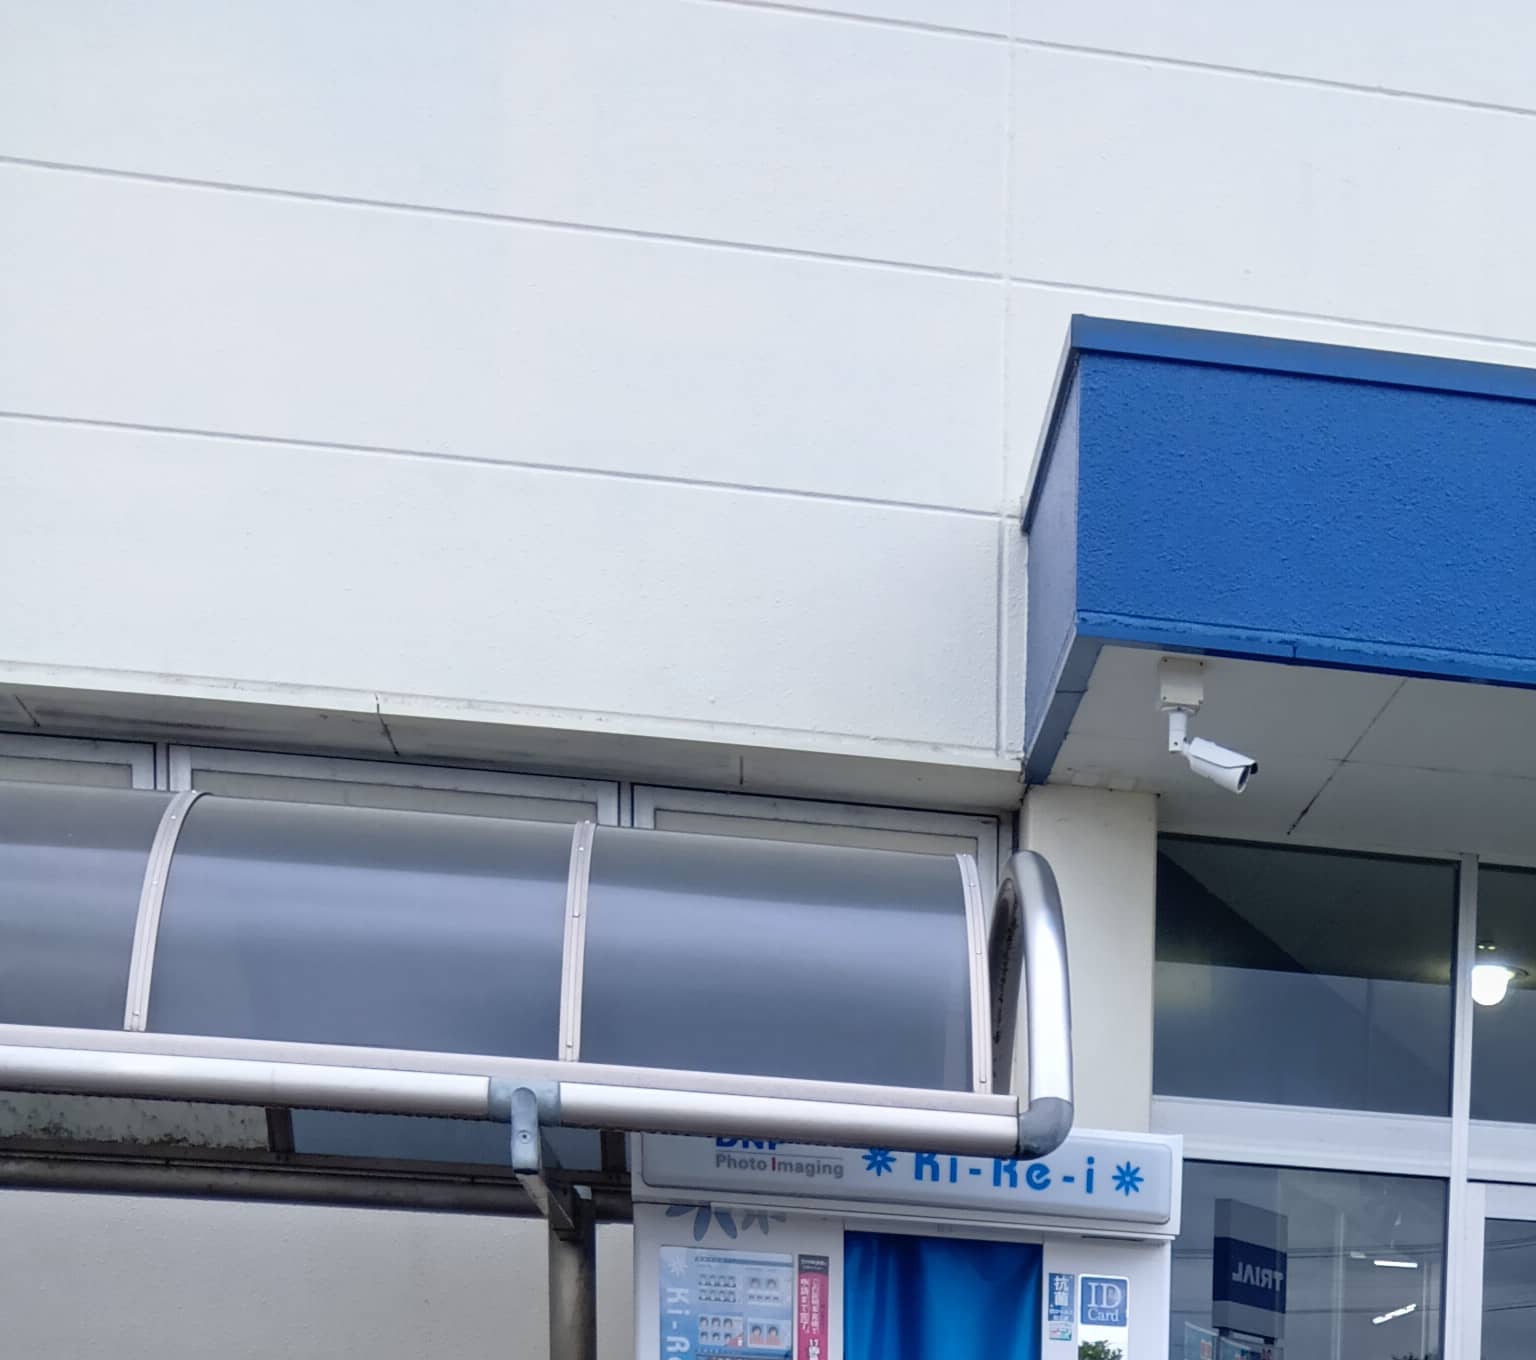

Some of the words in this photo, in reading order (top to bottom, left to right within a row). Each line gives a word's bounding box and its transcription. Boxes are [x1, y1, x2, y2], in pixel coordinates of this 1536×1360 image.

[716, 1153, 767, 1169] Photo
[771, 1157, 844, 1179] Imaging
[1087, 1282, 1121, 1308] ID
[1088, 1308, 1120, 1322] Card
